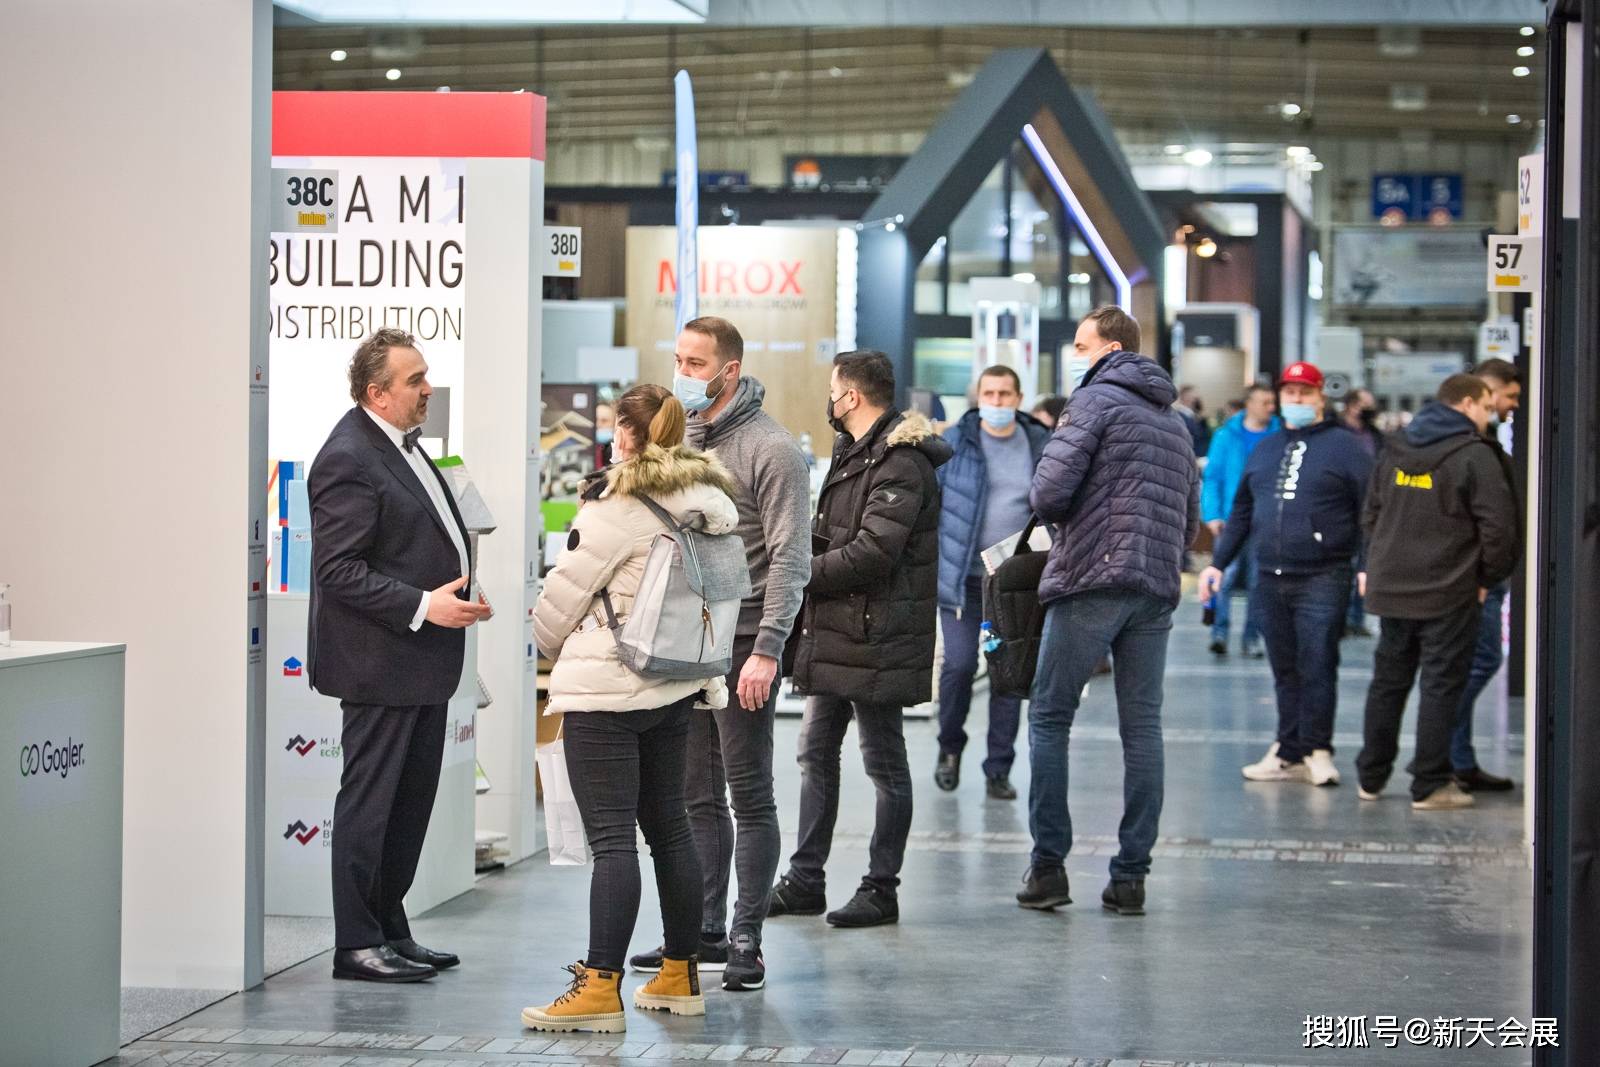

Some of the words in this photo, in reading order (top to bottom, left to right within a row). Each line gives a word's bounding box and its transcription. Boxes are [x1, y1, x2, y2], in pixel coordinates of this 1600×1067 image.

[286, 176, 334, 206] 38C
[551, 233, 578, 256] 38D
[1495, 243, 1523, 270] 57
[270, 305, 462, 341] ISTRIBUTION
